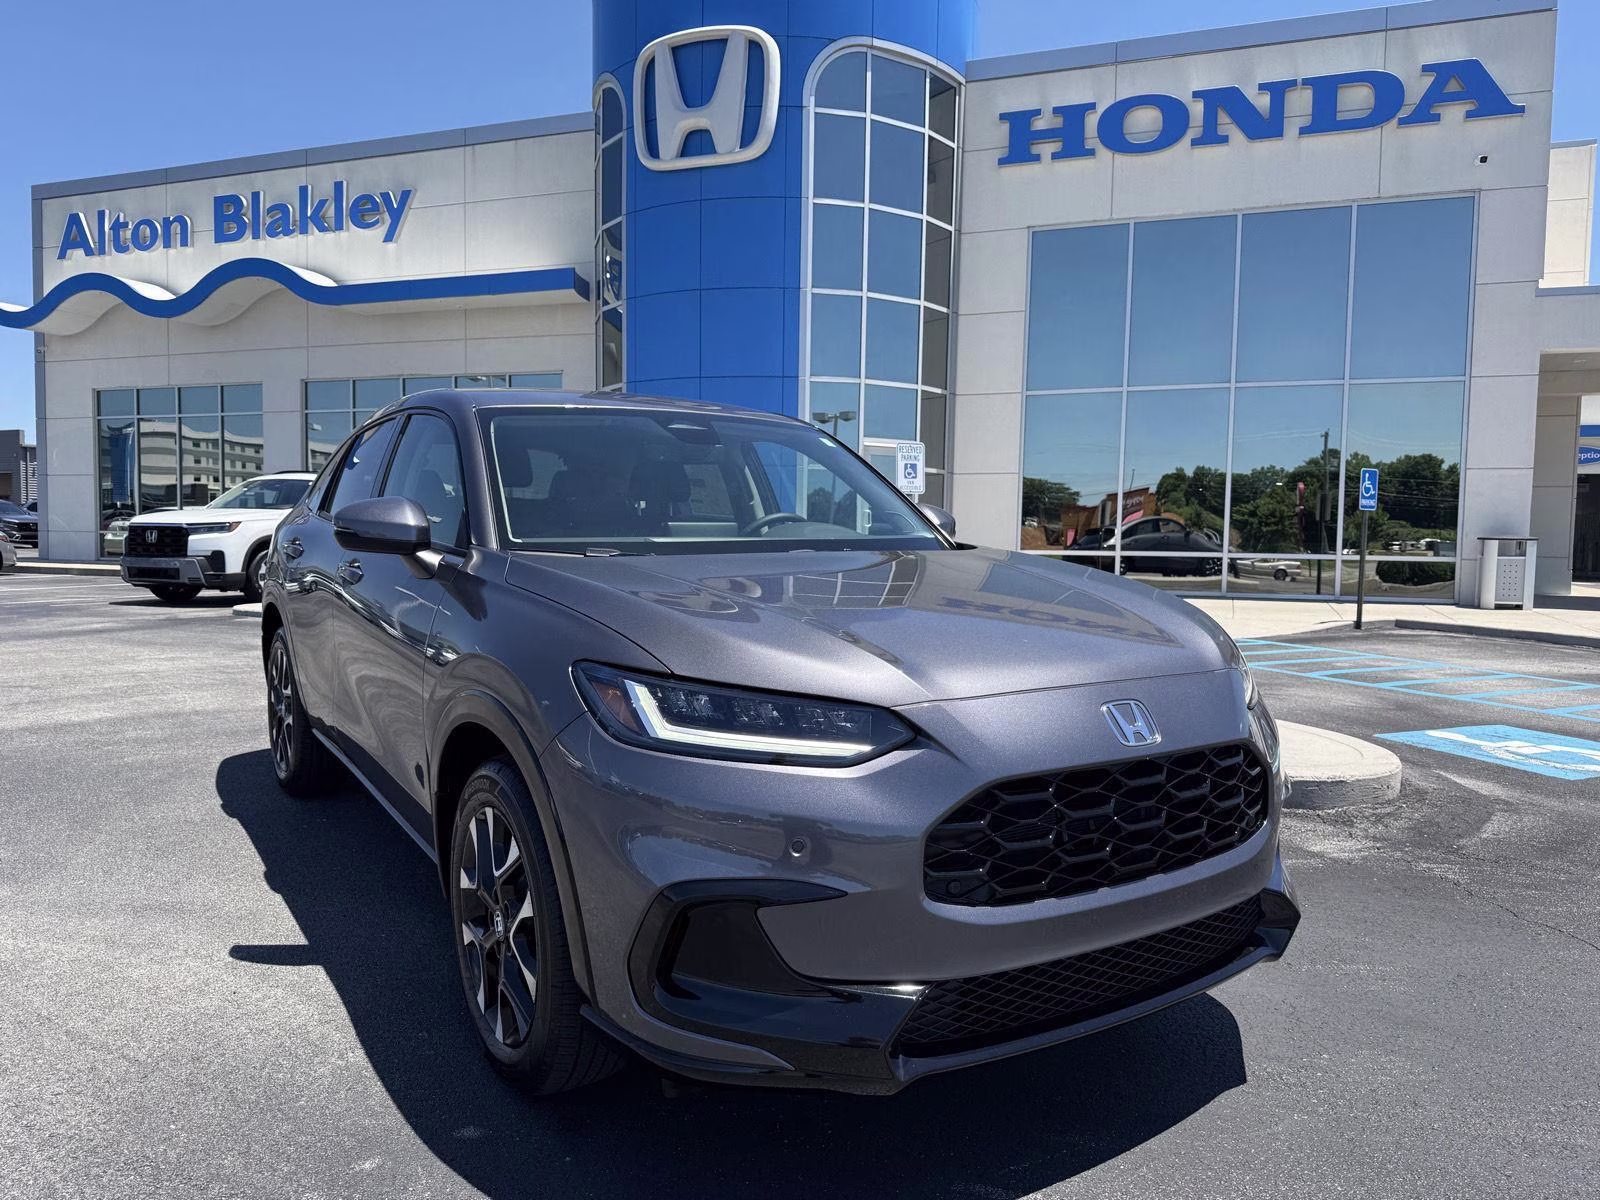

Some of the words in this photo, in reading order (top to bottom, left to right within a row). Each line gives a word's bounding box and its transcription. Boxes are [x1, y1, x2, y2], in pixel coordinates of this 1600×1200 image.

[998, 57, 1526, 166] HONDA
[57, 208, 191, 260] Alton
[213, 180, 413, 244] Blakley
[899, 445, 922, 454] RESERVED
[901, 454, 920, 462] PARKING
